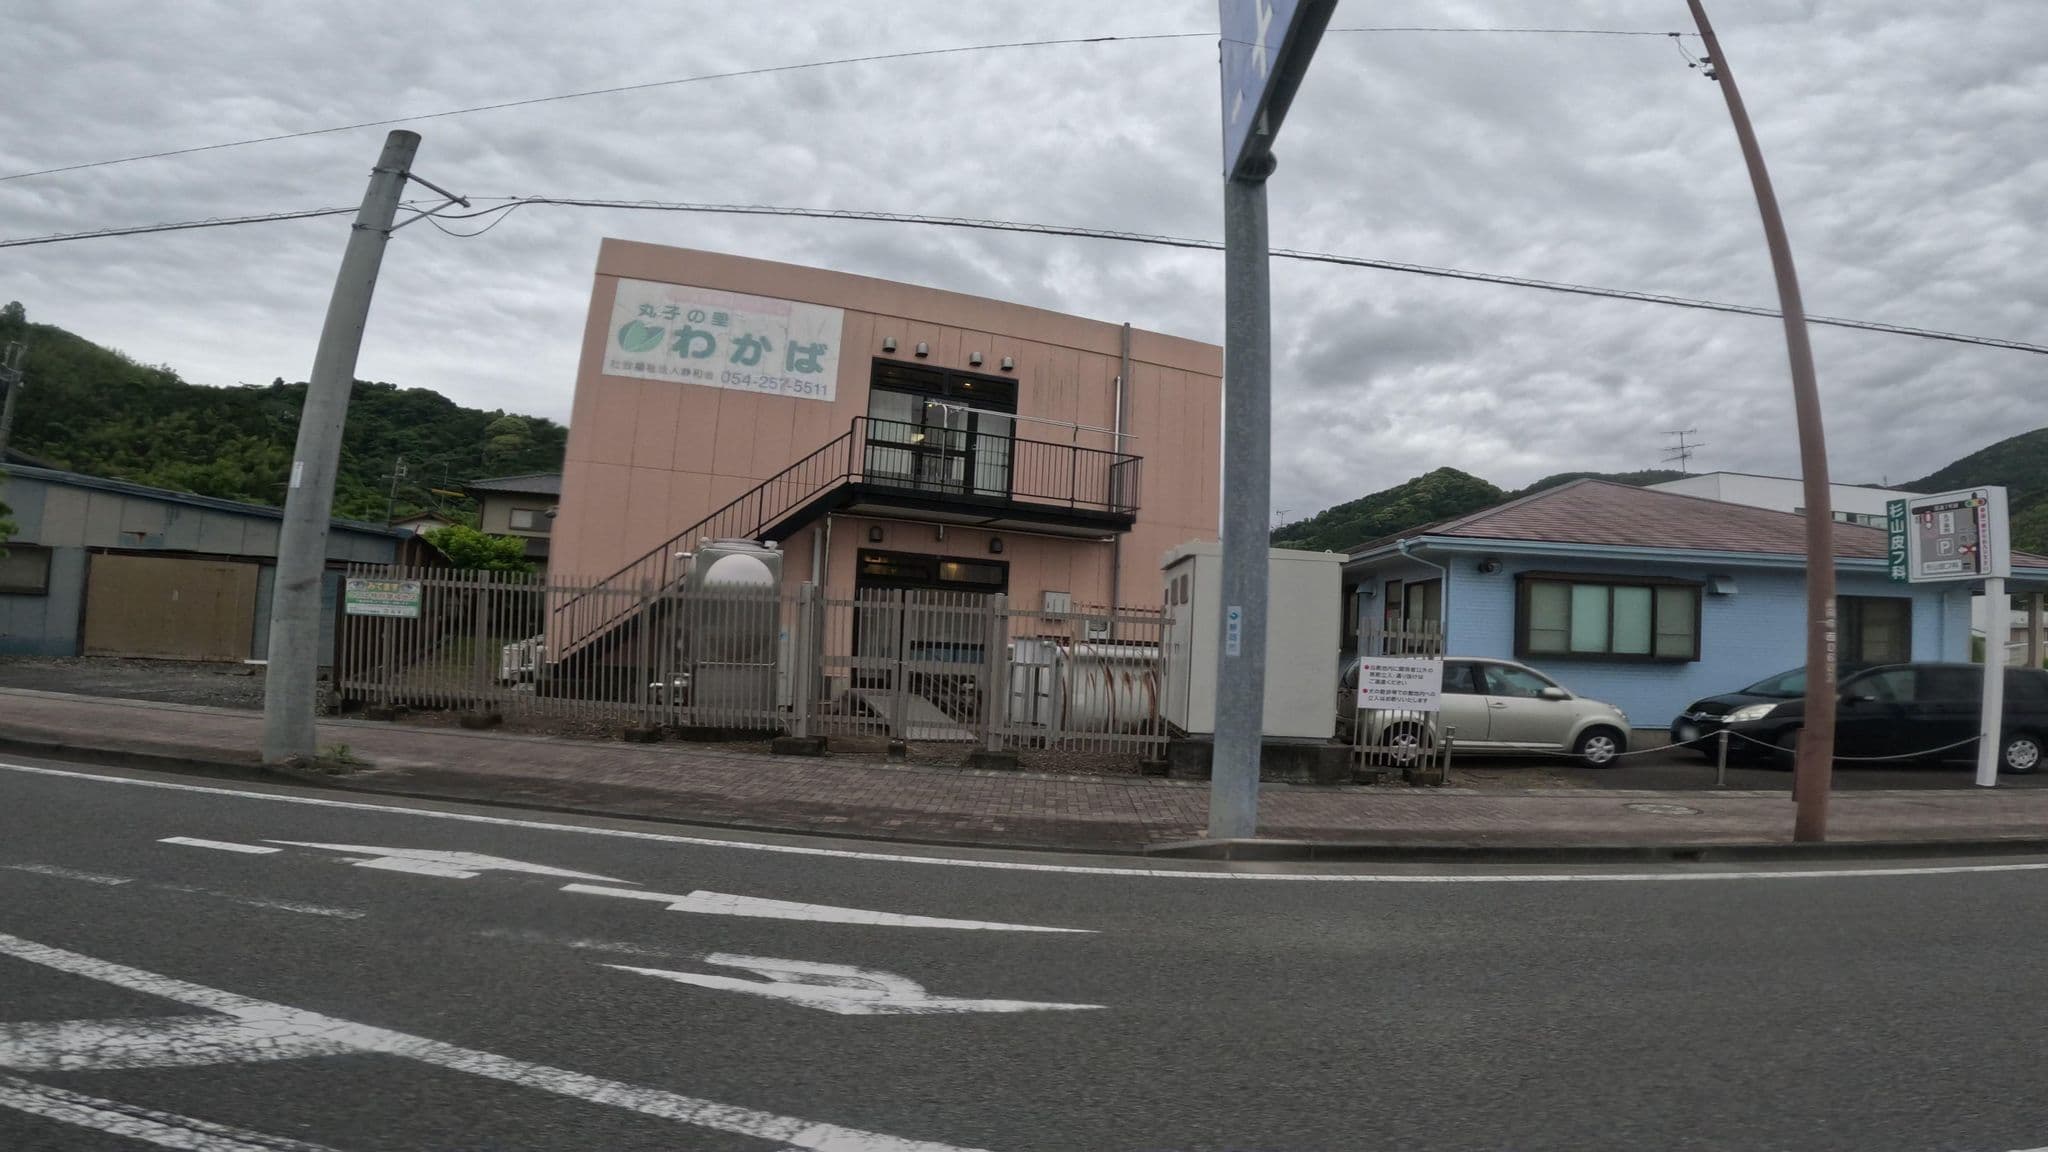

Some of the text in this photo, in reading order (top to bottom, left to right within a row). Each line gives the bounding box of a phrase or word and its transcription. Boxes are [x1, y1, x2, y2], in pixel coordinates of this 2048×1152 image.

[671, 324, 828, 374] わかば
[721, 371, 828, 396] 054-257-5511
[1889, 503, 1906, 580] 杉山皮フ科
